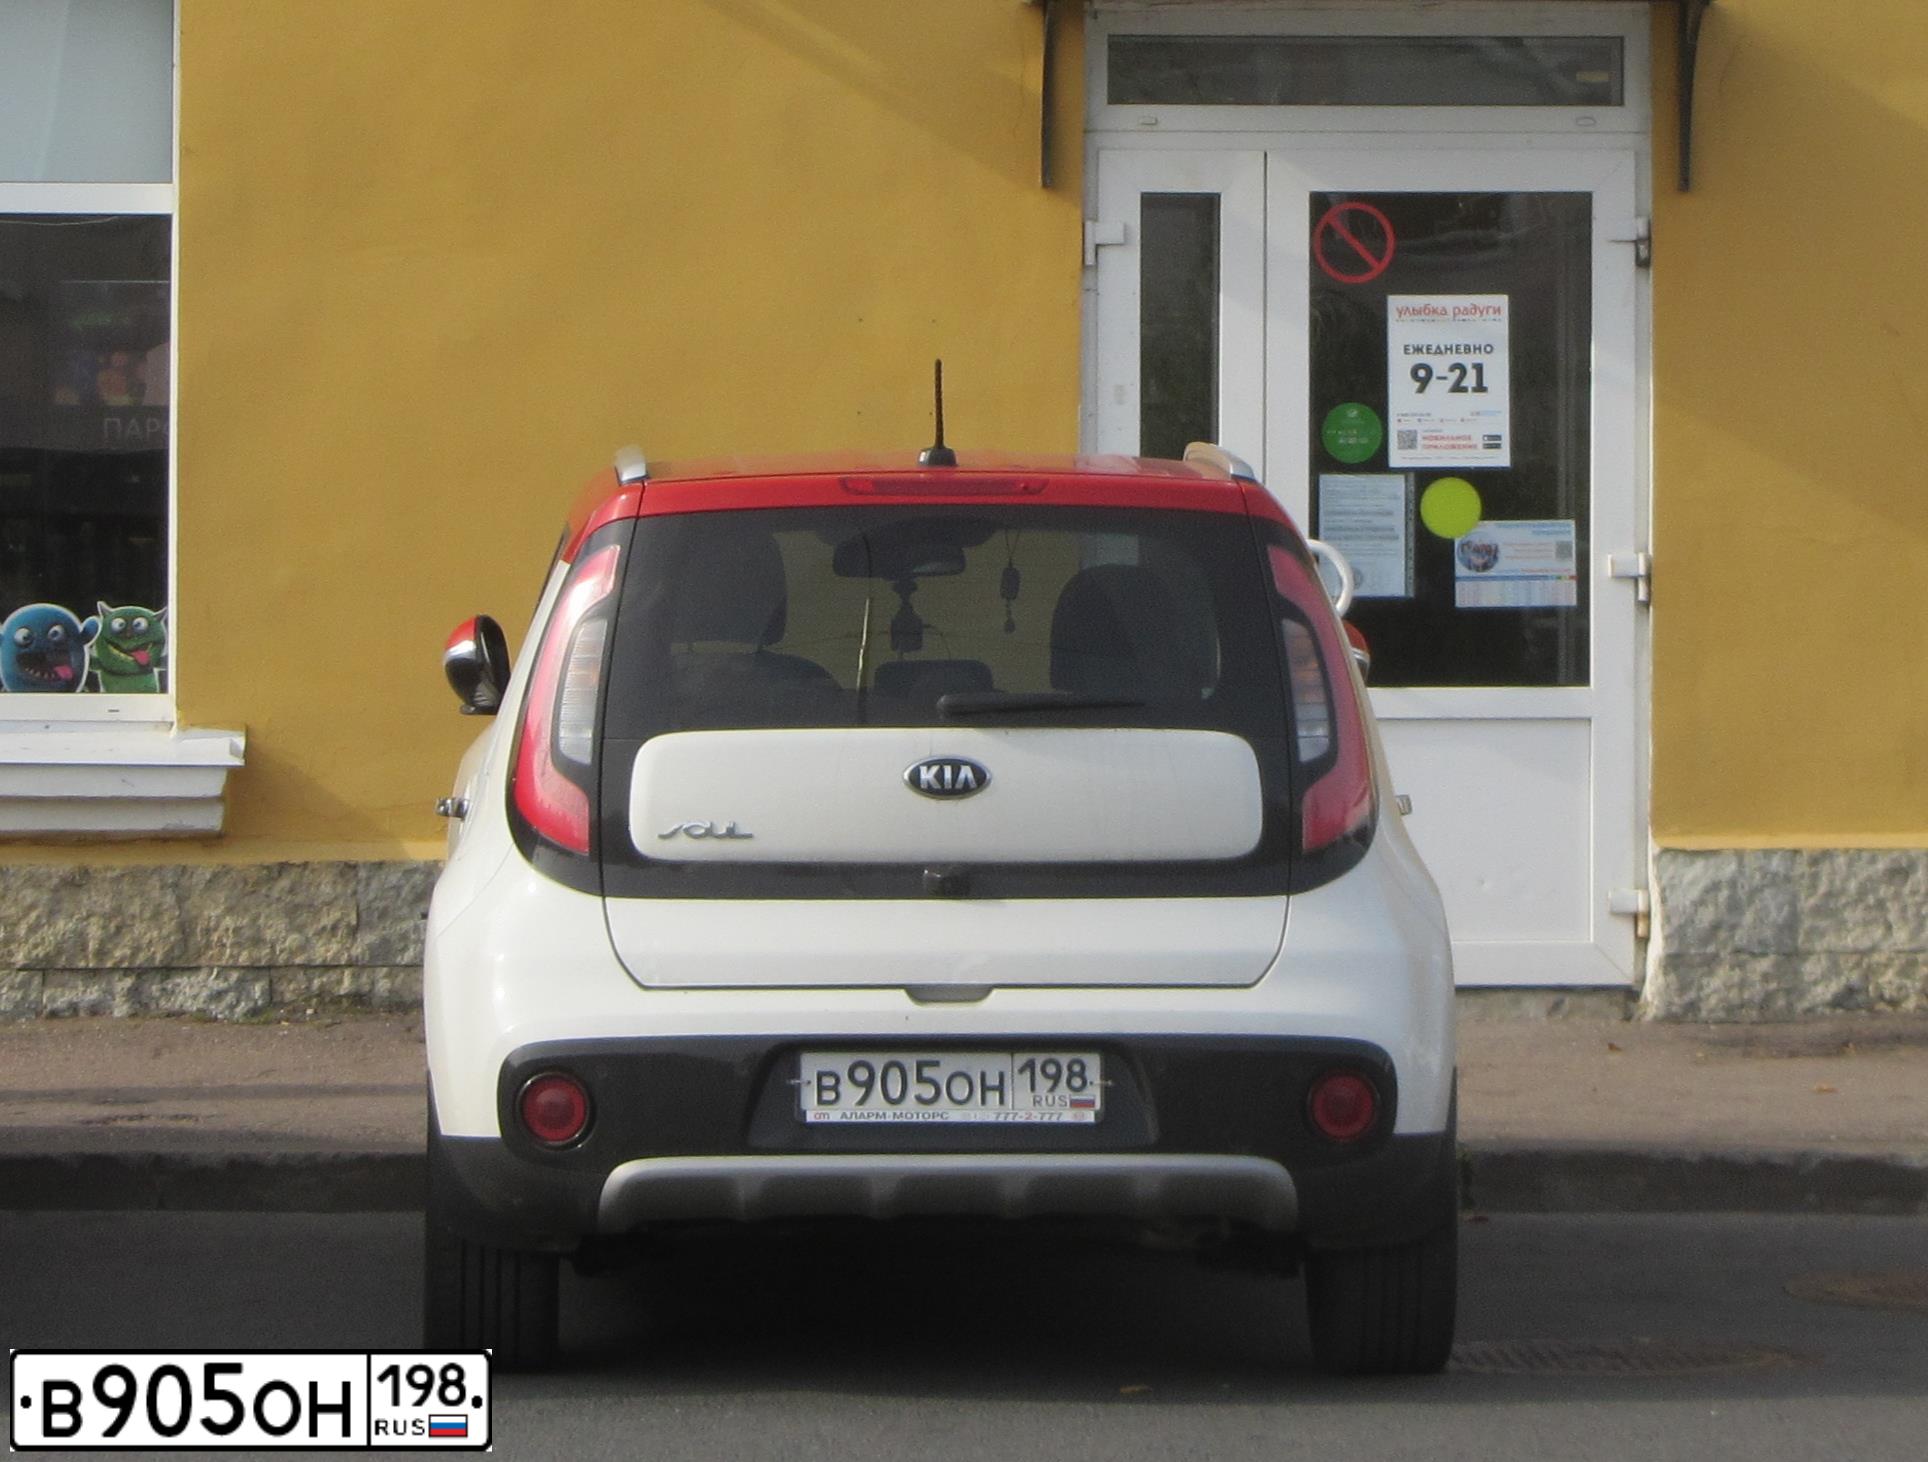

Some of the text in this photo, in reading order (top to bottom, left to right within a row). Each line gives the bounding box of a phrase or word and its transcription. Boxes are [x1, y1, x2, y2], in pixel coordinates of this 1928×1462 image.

[1395, 303, 1502, 319] улыбка радуги
[1403, 343, 1494, 356] ЕЖЕДНЕВНО
[1410, 362, 1489, 394] 9-21
[919, 764, 977, 790] KIA
[815, 1057, 1089, 1106] В905ОН 198
[1032, 1095, 1068, 1107] RUS
